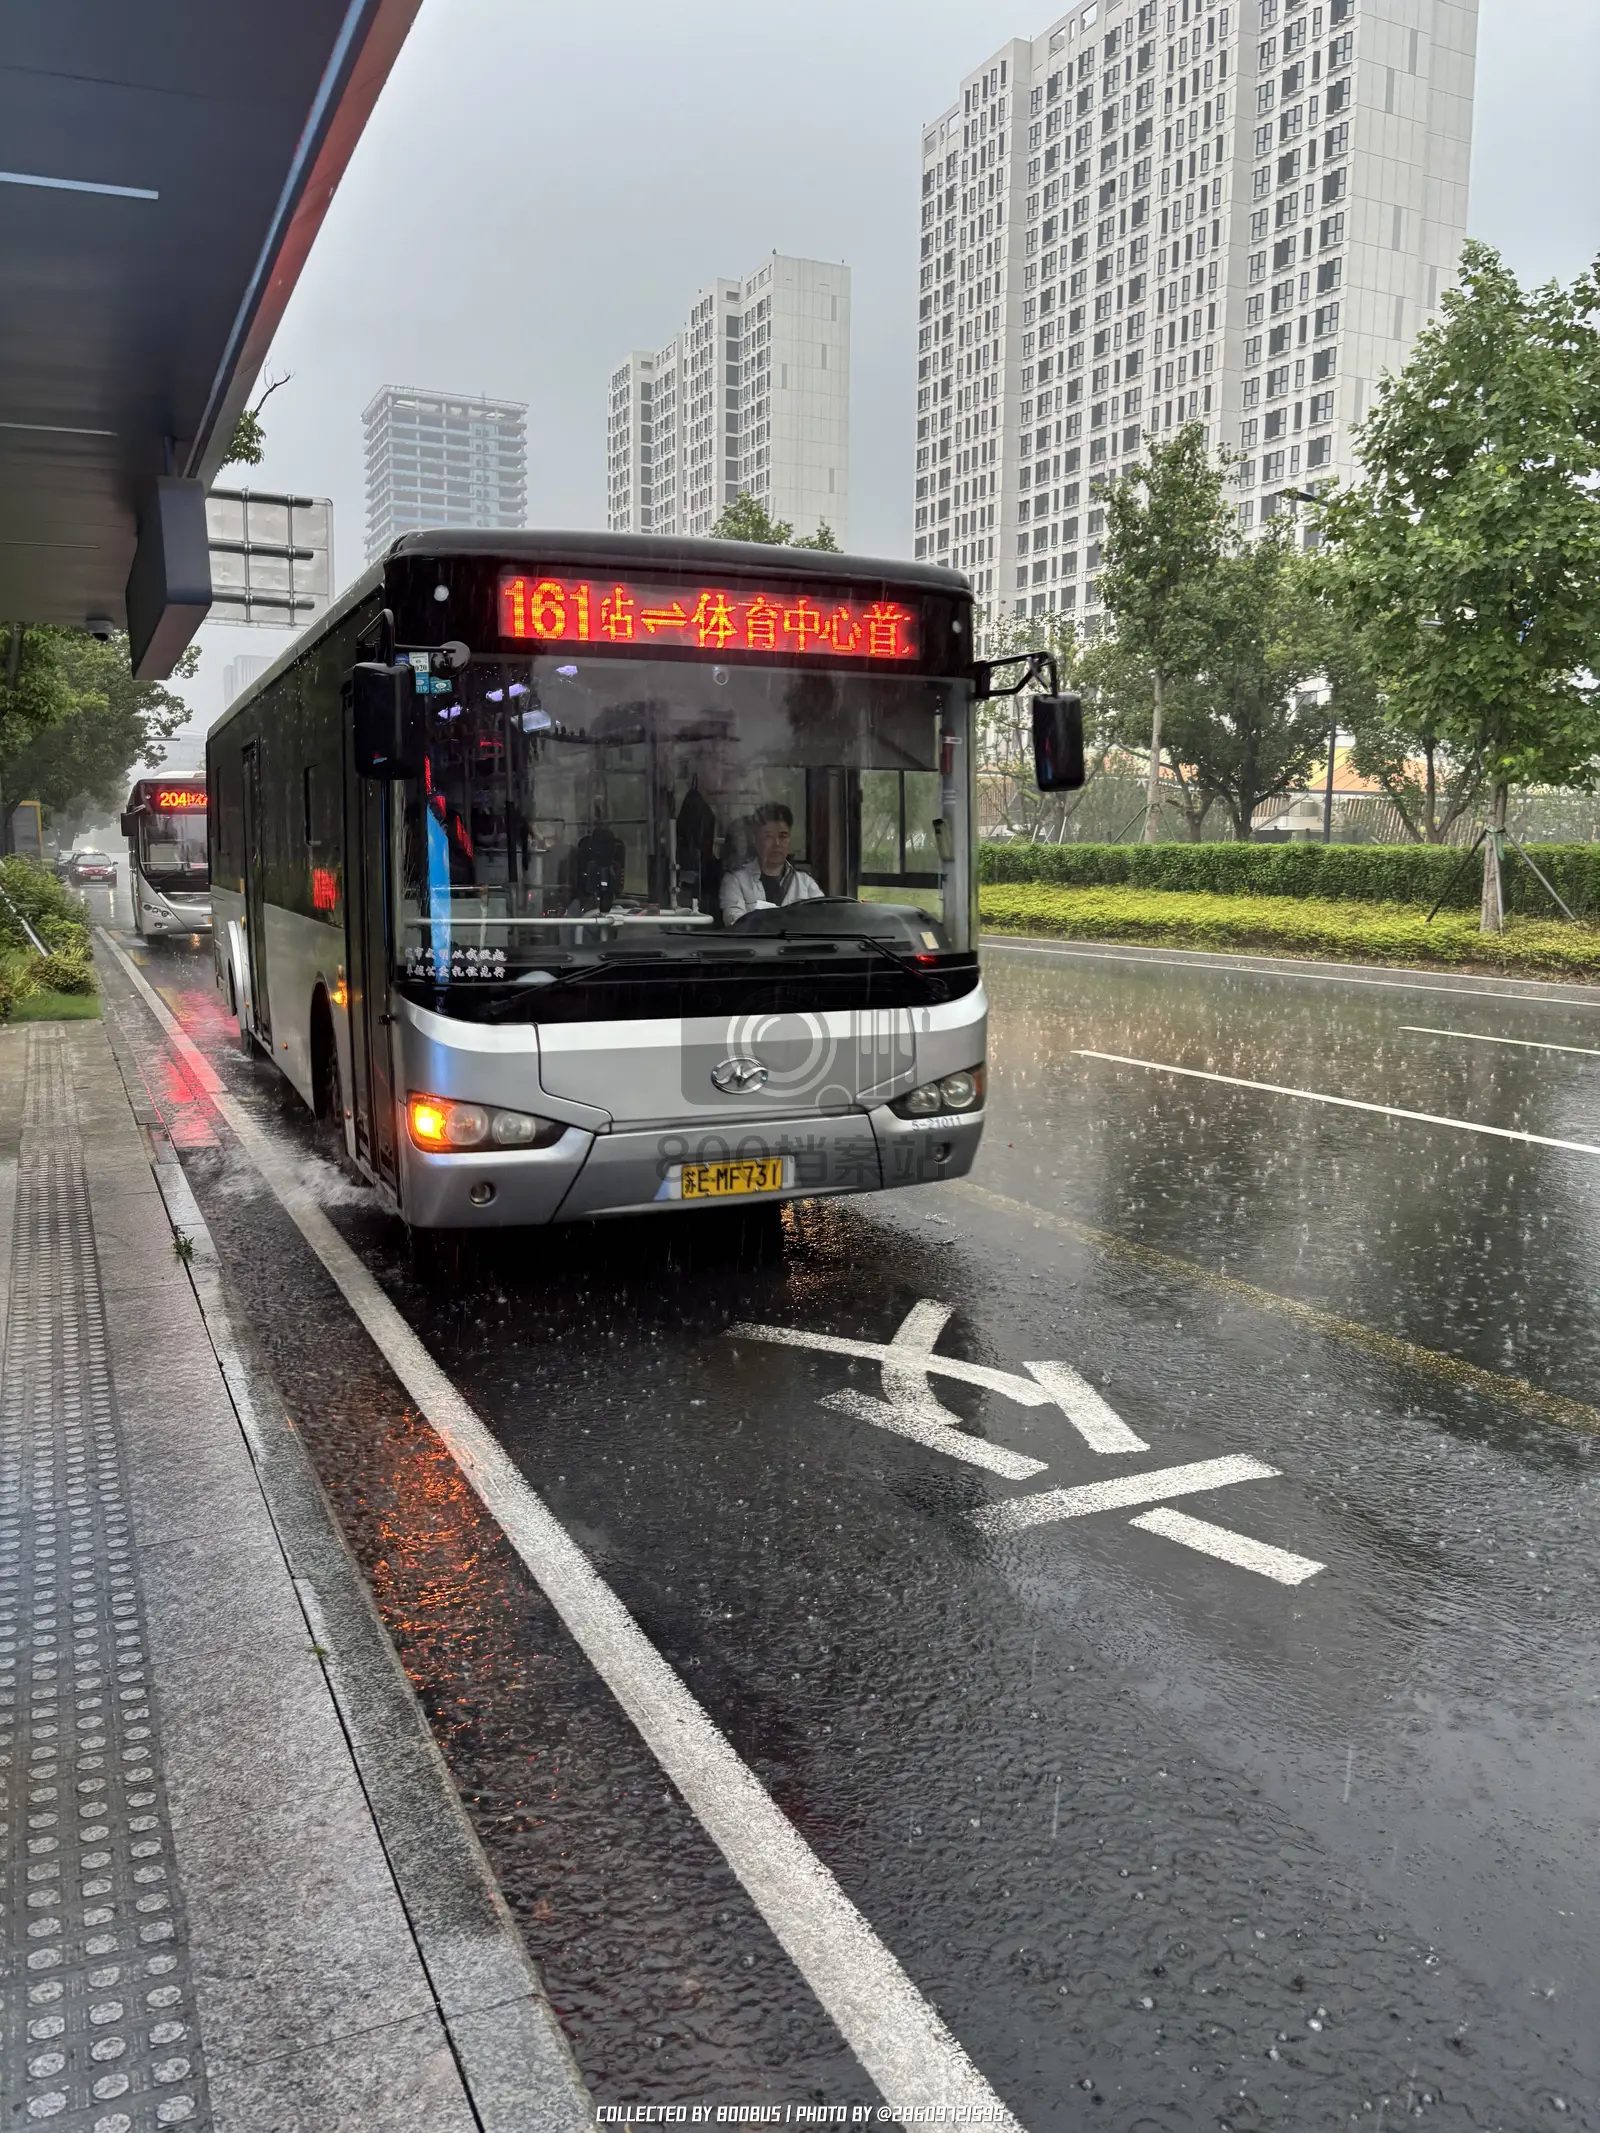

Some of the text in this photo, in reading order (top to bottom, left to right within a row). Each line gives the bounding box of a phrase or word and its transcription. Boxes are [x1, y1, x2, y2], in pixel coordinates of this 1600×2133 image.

[505, 579, 589, 641] 161
[690, 592, 910, 656] 体育中心首
[160, 791, 187, 807] 204
